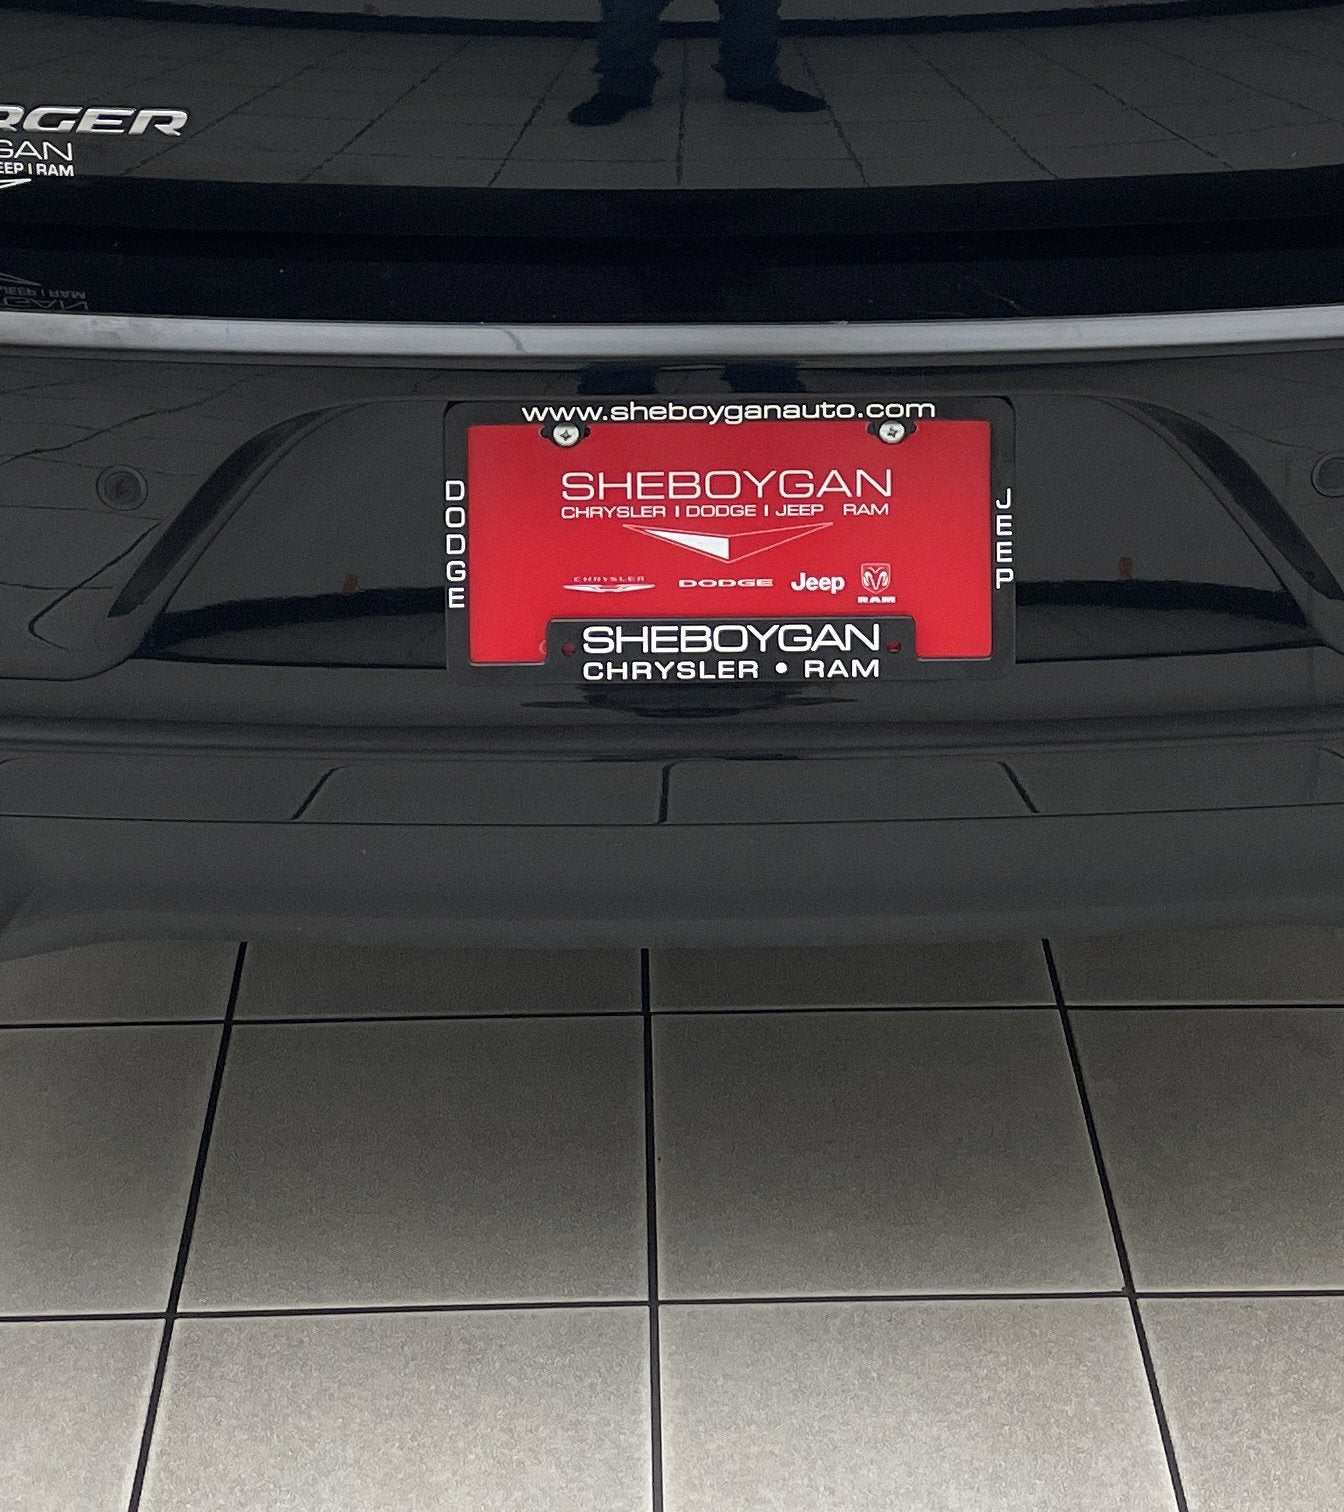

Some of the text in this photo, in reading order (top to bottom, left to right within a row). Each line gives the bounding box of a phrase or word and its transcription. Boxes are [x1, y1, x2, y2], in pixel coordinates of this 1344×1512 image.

[36, 164, 75, 177] RAM
[521, 401, 936, 426] www.sheboyganauto.com
[561, 468, 892, 501] SHEBOYGAN
[561, 503, 889, 519] CHRYSLER DODGE JEEP RAM
[445, 479, 467, 610] DODGE
[996, 488, 1014, 590] JEEP
[573, 575, 645, 583] CHRYSLER
[678, 578, 774, 588] DODGE
[791, 572, 846, 595] Jeep
[857, 596, 896, 604] RAM
[581, 623, 880, 654] SHEBOYGAN
[582, 659, 880, 681] CHRYSLER RAM
